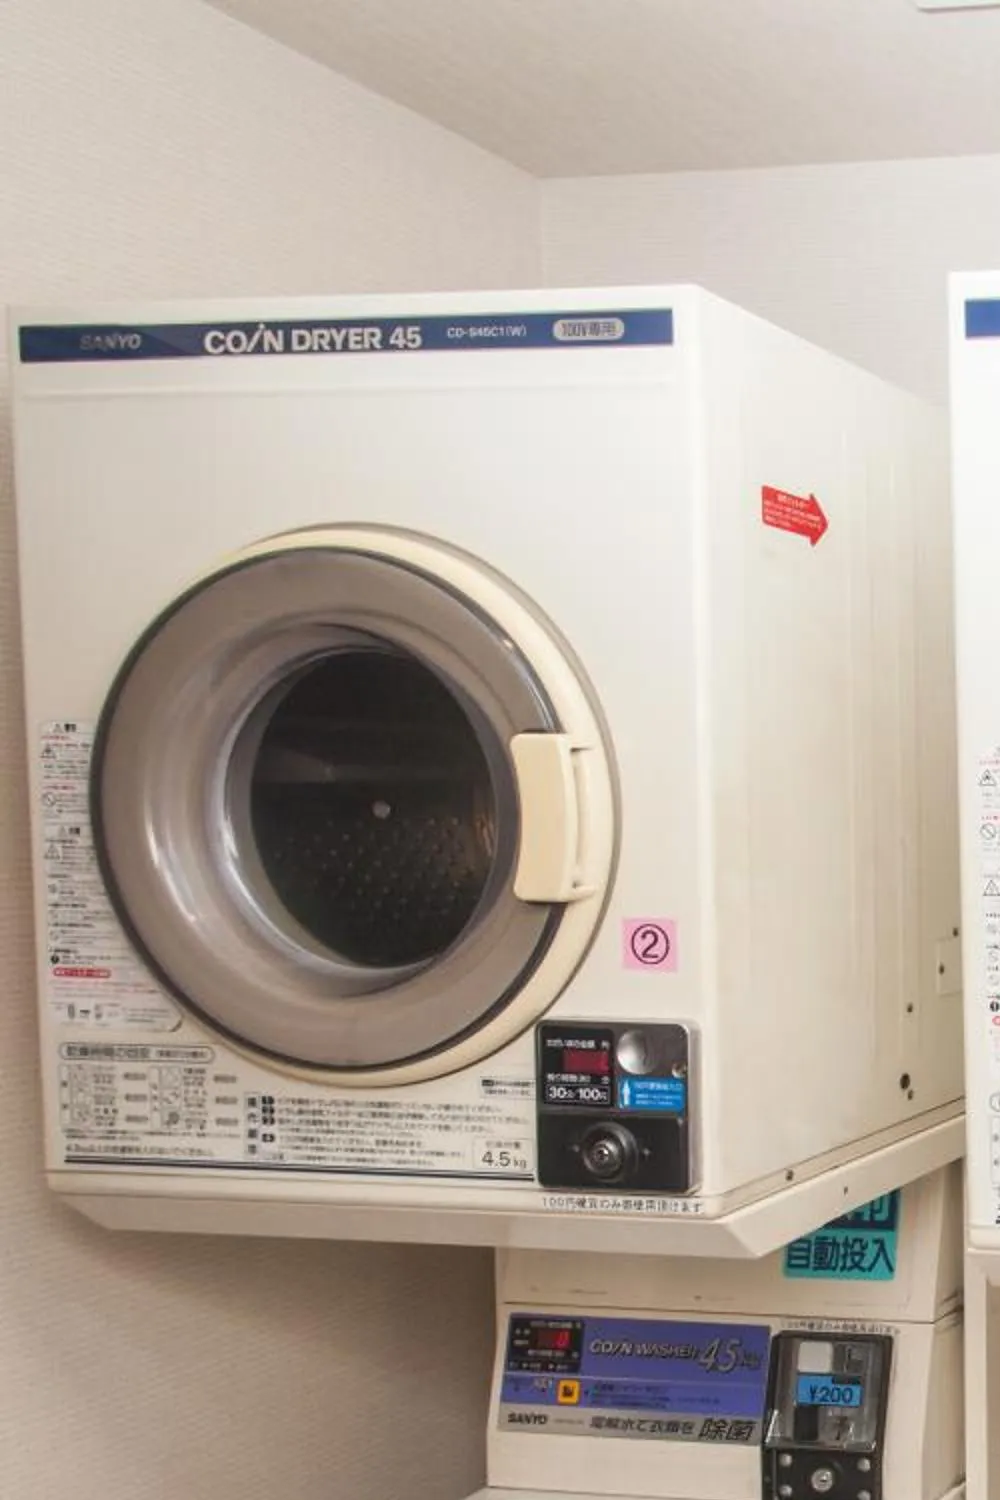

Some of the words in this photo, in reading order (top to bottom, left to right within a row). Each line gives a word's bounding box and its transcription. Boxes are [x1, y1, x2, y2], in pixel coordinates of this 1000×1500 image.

[79, 333, 143, 352] SANYO
[290, 327, 383, 352] DRYER
[389, 325, 422, 349] 45
[788, 1235, 895, 1273] 自動投入
